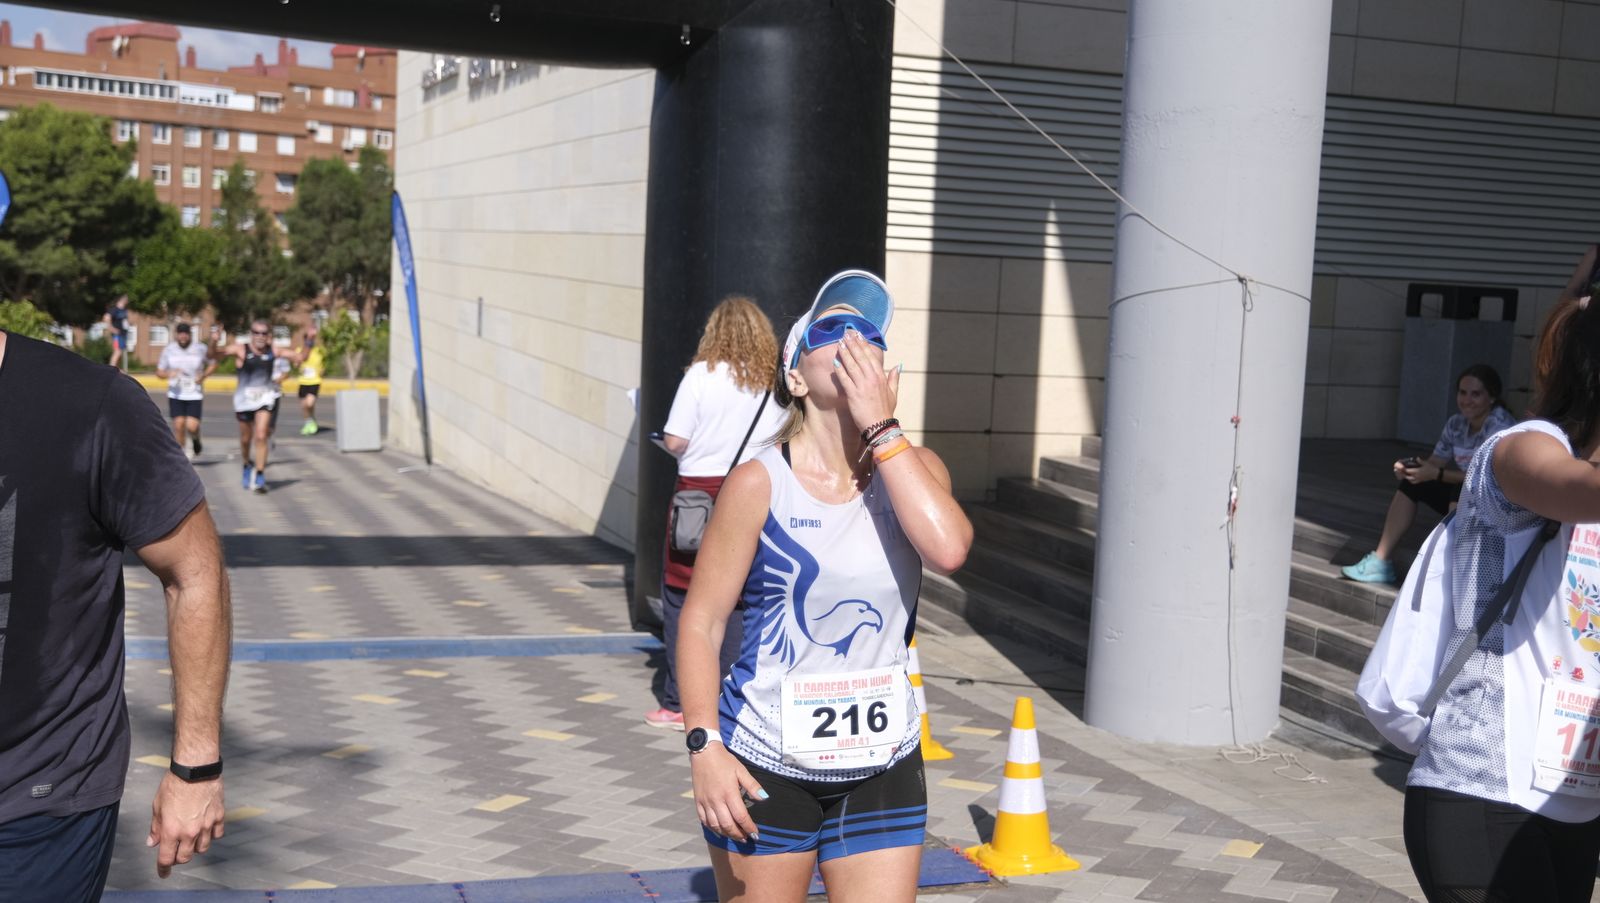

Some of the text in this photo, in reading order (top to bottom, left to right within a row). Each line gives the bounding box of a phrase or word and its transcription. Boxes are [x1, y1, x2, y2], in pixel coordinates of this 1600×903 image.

[803, 680, 850, 693] CARRERA
[851, 677, 868, 690] SIN
[870, 674, 893, 687] HUMO
[812, 700, 888, 739] 216
[1557, 722, 1600, 761] 11
